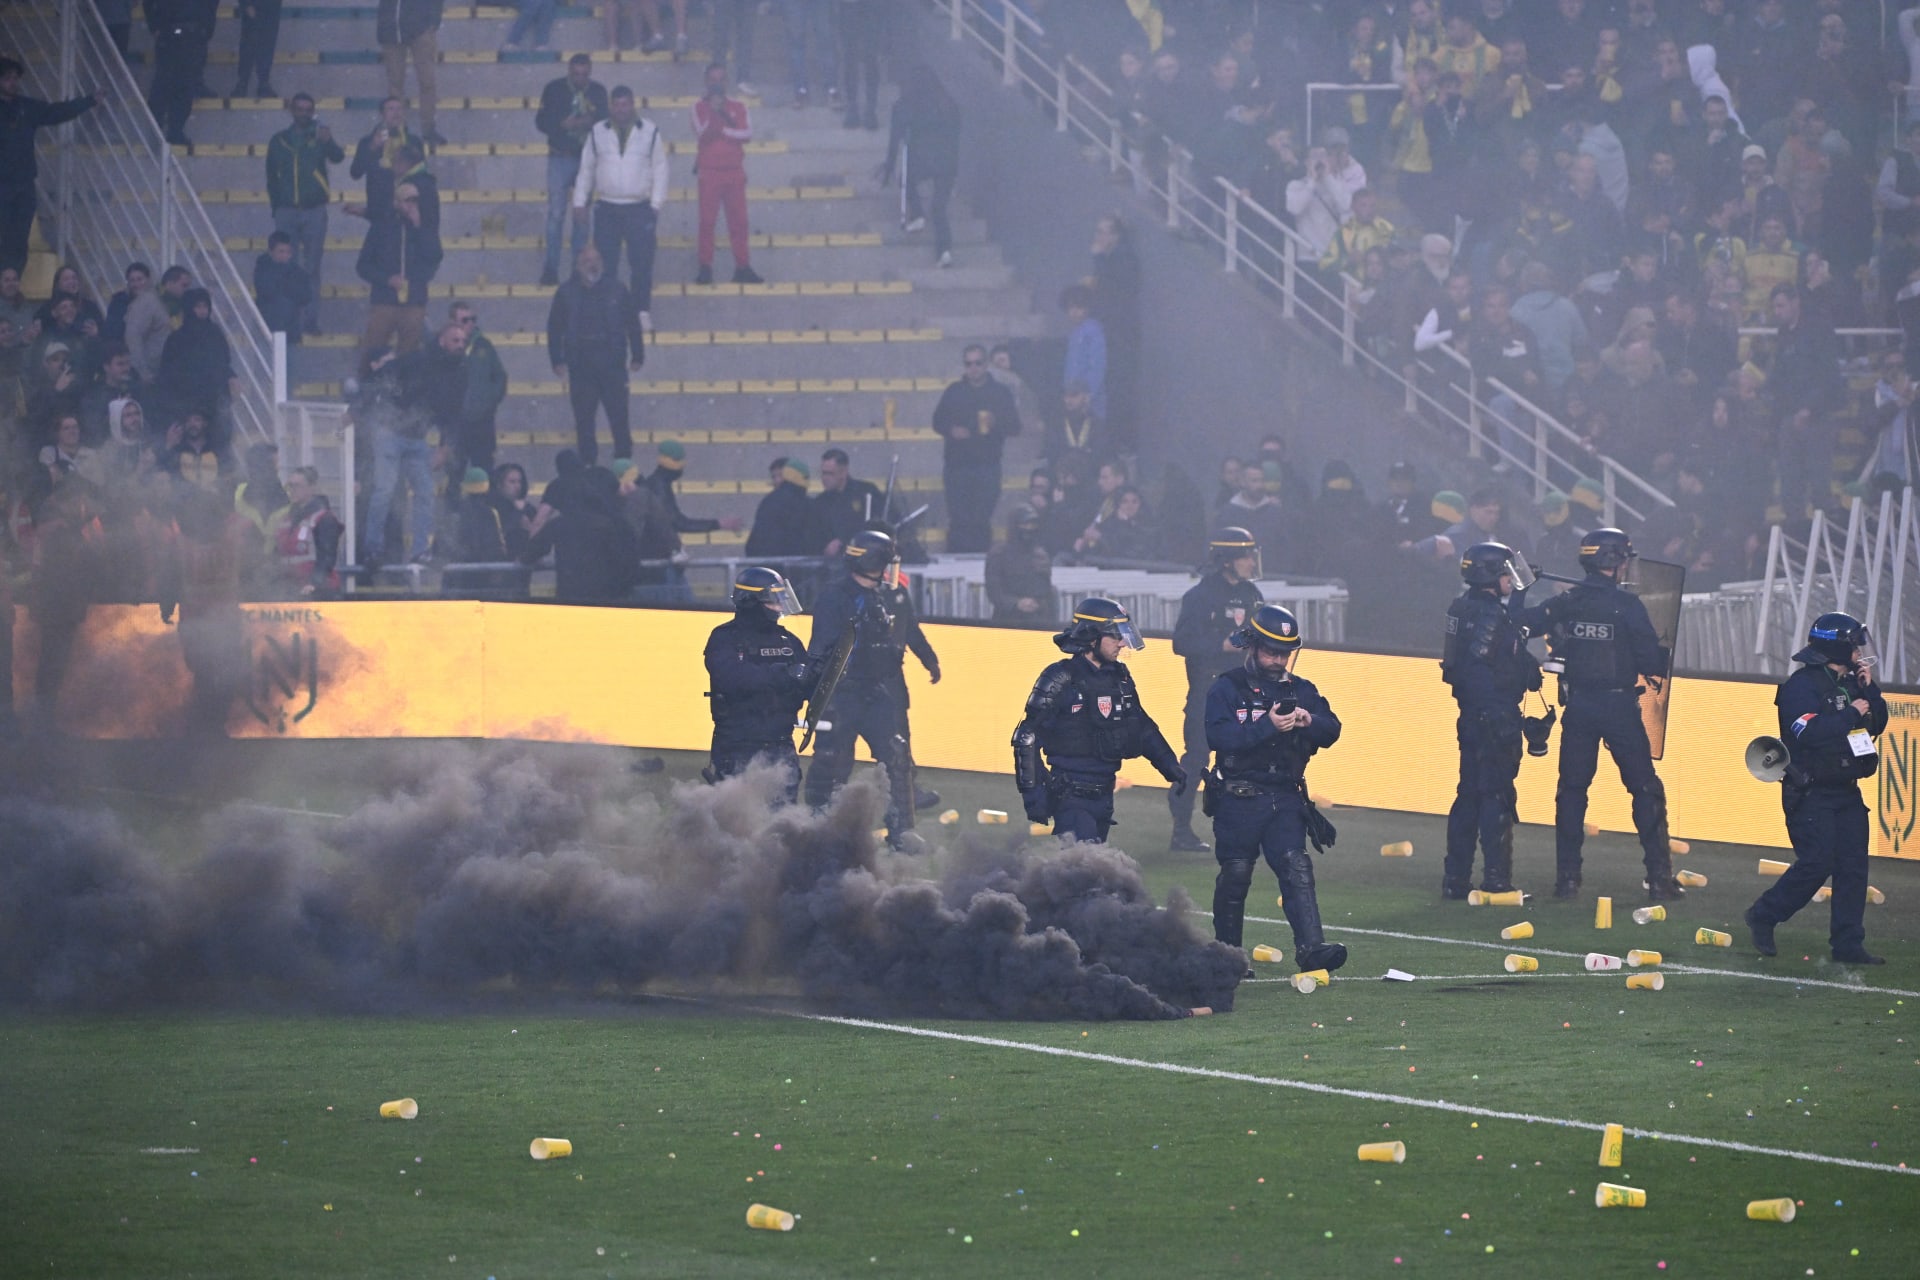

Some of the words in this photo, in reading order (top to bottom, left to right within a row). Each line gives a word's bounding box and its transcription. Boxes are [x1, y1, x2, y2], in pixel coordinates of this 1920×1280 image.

[260, 608, 323, 623] NANTES
[1573, 624, 1609, 638] CRS
[760, 648, 781, 656] CRS
[1888, 701, 1920, 720] NANTES
